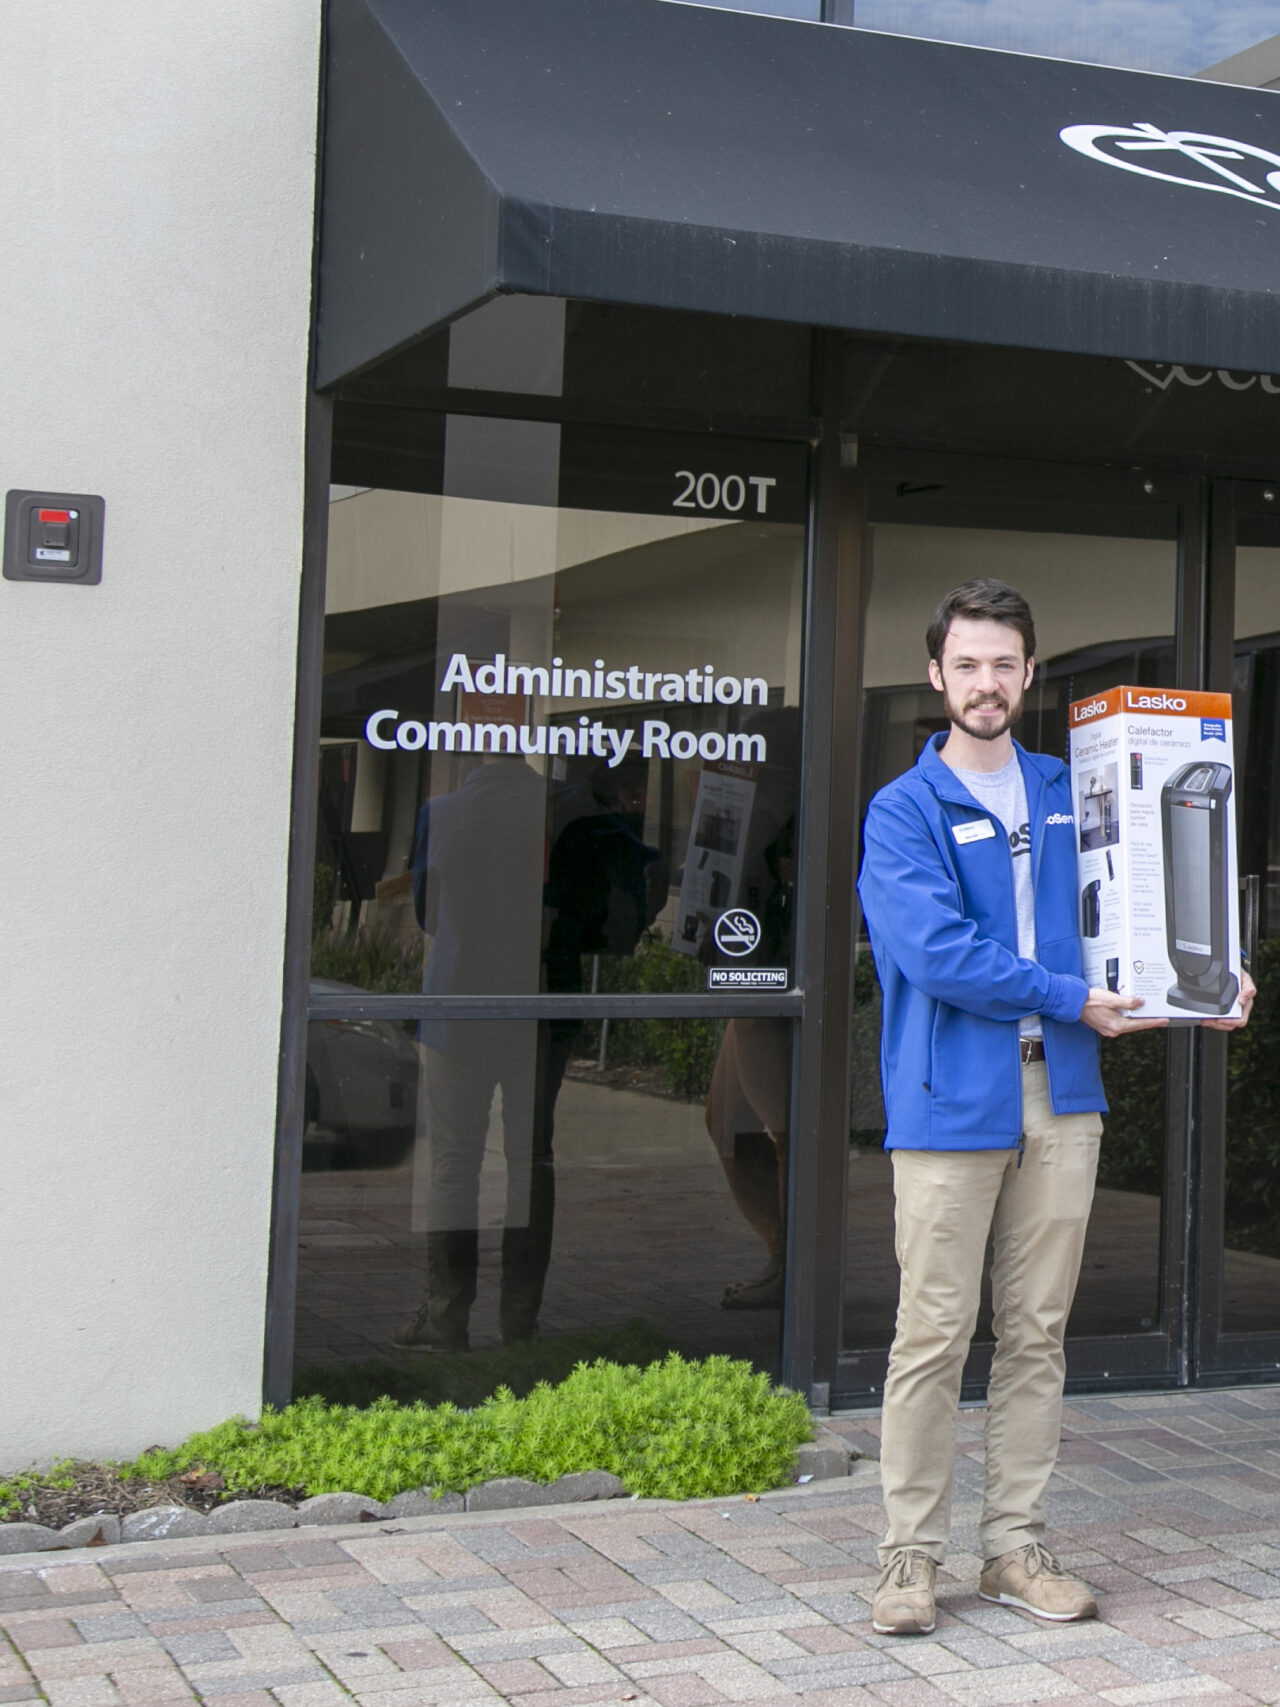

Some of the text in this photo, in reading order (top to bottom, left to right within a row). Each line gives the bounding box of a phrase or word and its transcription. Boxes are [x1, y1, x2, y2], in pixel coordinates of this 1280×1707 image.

[440, 653, 769, 706] Administration
[1074, 700, 1108, 722] Lasko
[1127, 691, 1187, 711] Lasko
[364, 709, 635, 768] Community
[642, 720, 767, 762] Room
[1127, 725, 1173, 738] Calefactor
[1127, 737, 1148, 747] digital
[1149, 738, 1159, 746] de
[1074, 743, 1099, 759] Ceramic
[1099, 737, 1119, 751] Heater
[712, 972, 785, 982] NO SOLICITING
